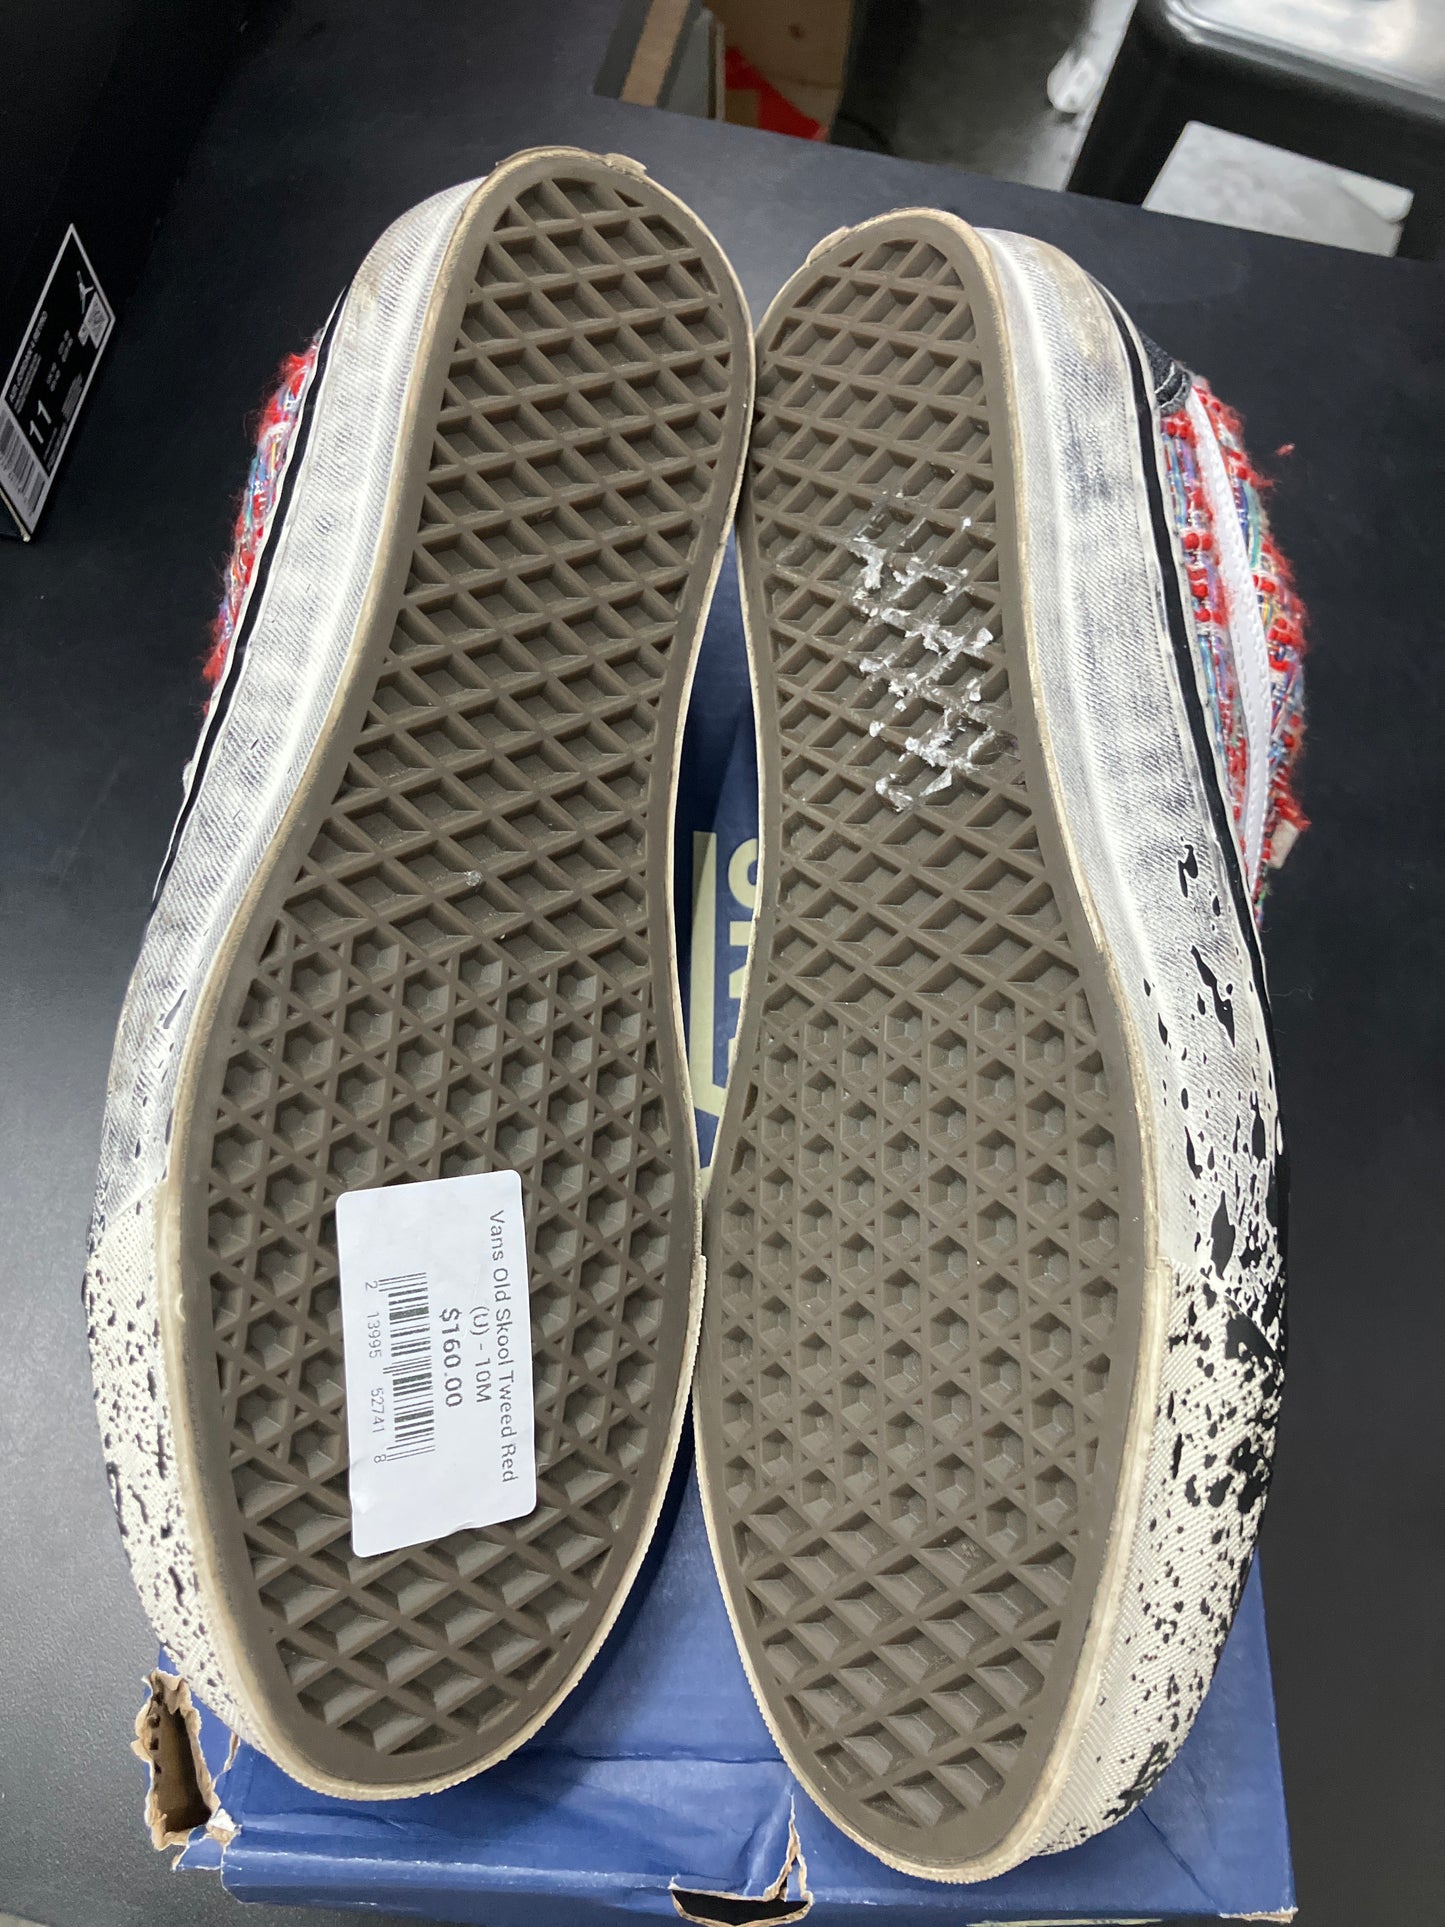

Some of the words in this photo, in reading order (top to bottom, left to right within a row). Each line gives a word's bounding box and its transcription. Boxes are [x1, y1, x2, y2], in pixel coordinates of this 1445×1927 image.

[30, 400, 52, 443] 11
[489, 1210, 505, 1261] Vans
[364, 1280, 378, 1290] 2
[493, 1267, 511, 1302] Old
[367, 1311, 383, 1359] 13995
[469, 1306, 490, 1336] (U)
[496, 1307, 514, 1369] Skool
[439, 1308, 463, 1408] $160.00
[474, 1356, 493, 1402] 10M
[370, 1387, 385, 1433] 52741
[499, 1370, 517, 1438] Tweed
[373, 1453, 387, 1463] 8
[501, 1443, 519, 1482] Red
